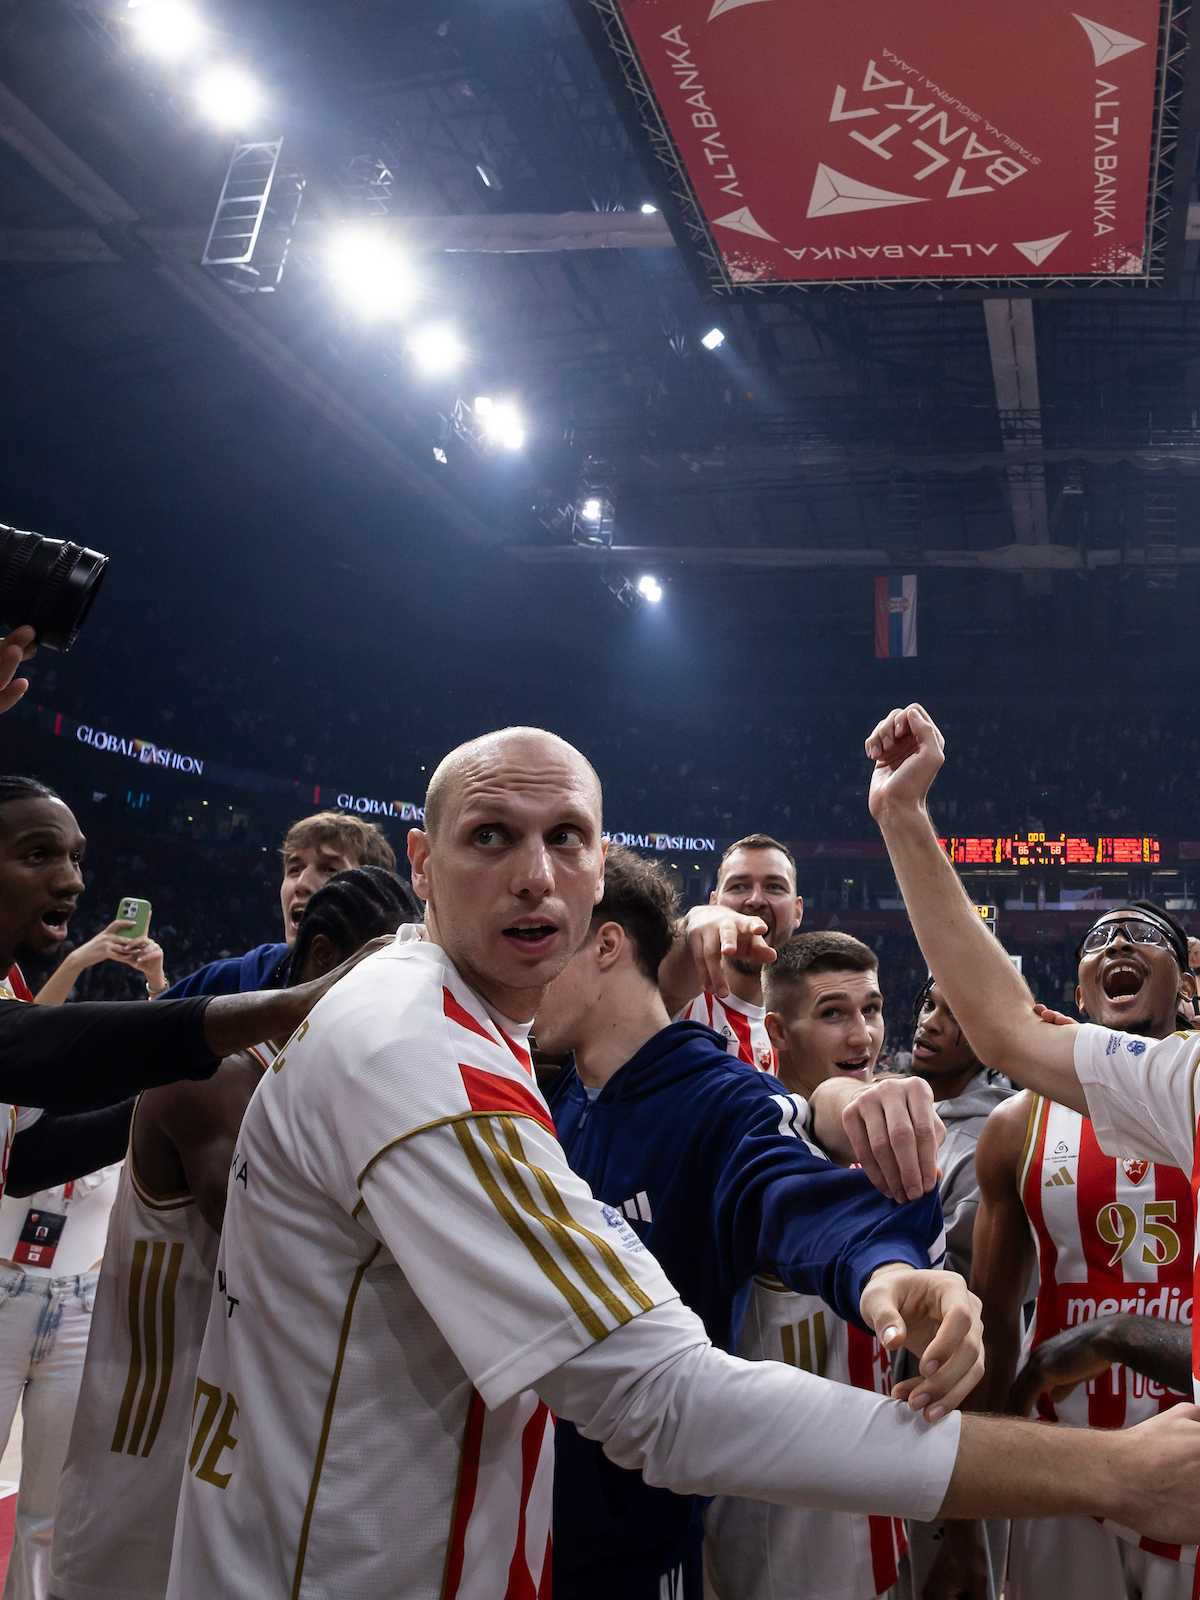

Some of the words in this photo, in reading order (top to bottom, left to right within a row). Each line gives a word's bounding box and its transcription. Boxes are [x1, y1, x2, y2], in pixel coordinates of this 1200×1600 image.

[883, 48, 919, 75] JAKA
[660, 24, 744, 198] ALTABANKA
[862, 59, 1028, 186] BANKA
[926, 79, 982, 123] SIGURNA
[829, 84, 995, 198] ALTA
[1094, 79, 1120, 237] ALTABANKA
[783, 243, 998, 261] ALTABANKA
[77, 725, 137, 758] GLOBAL
[140, 744, 204, 775] FASHION
[337, 793, 398, 817] GLOBAL
[656, 834, 715, 851] FASHION
[1018, 845, 1029, 855] 86
[1050, 845, 1061, 855] 68
[1096, 1200, 1180, 1267] 95
